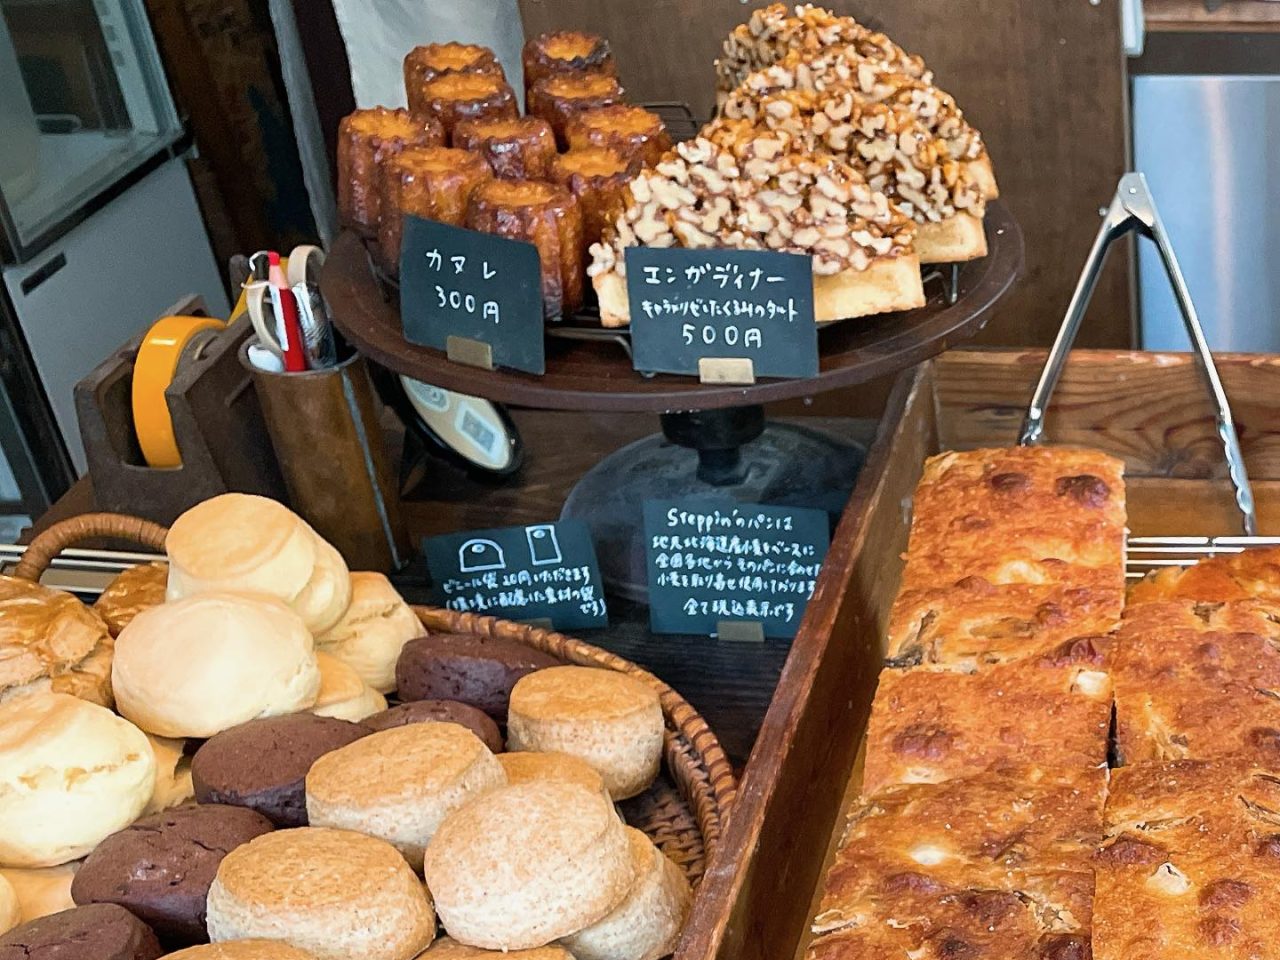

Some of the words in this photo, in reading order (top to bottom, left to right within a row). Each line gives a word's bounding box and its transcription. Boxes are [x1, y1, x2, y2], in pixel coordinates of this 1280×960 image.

[426, 248, 497, 280] カヌレ
[643, 263, 786, 291] エンガディナー
[435, 286, 500, 324] 300円
[683, 323, 762, 348] 500円
